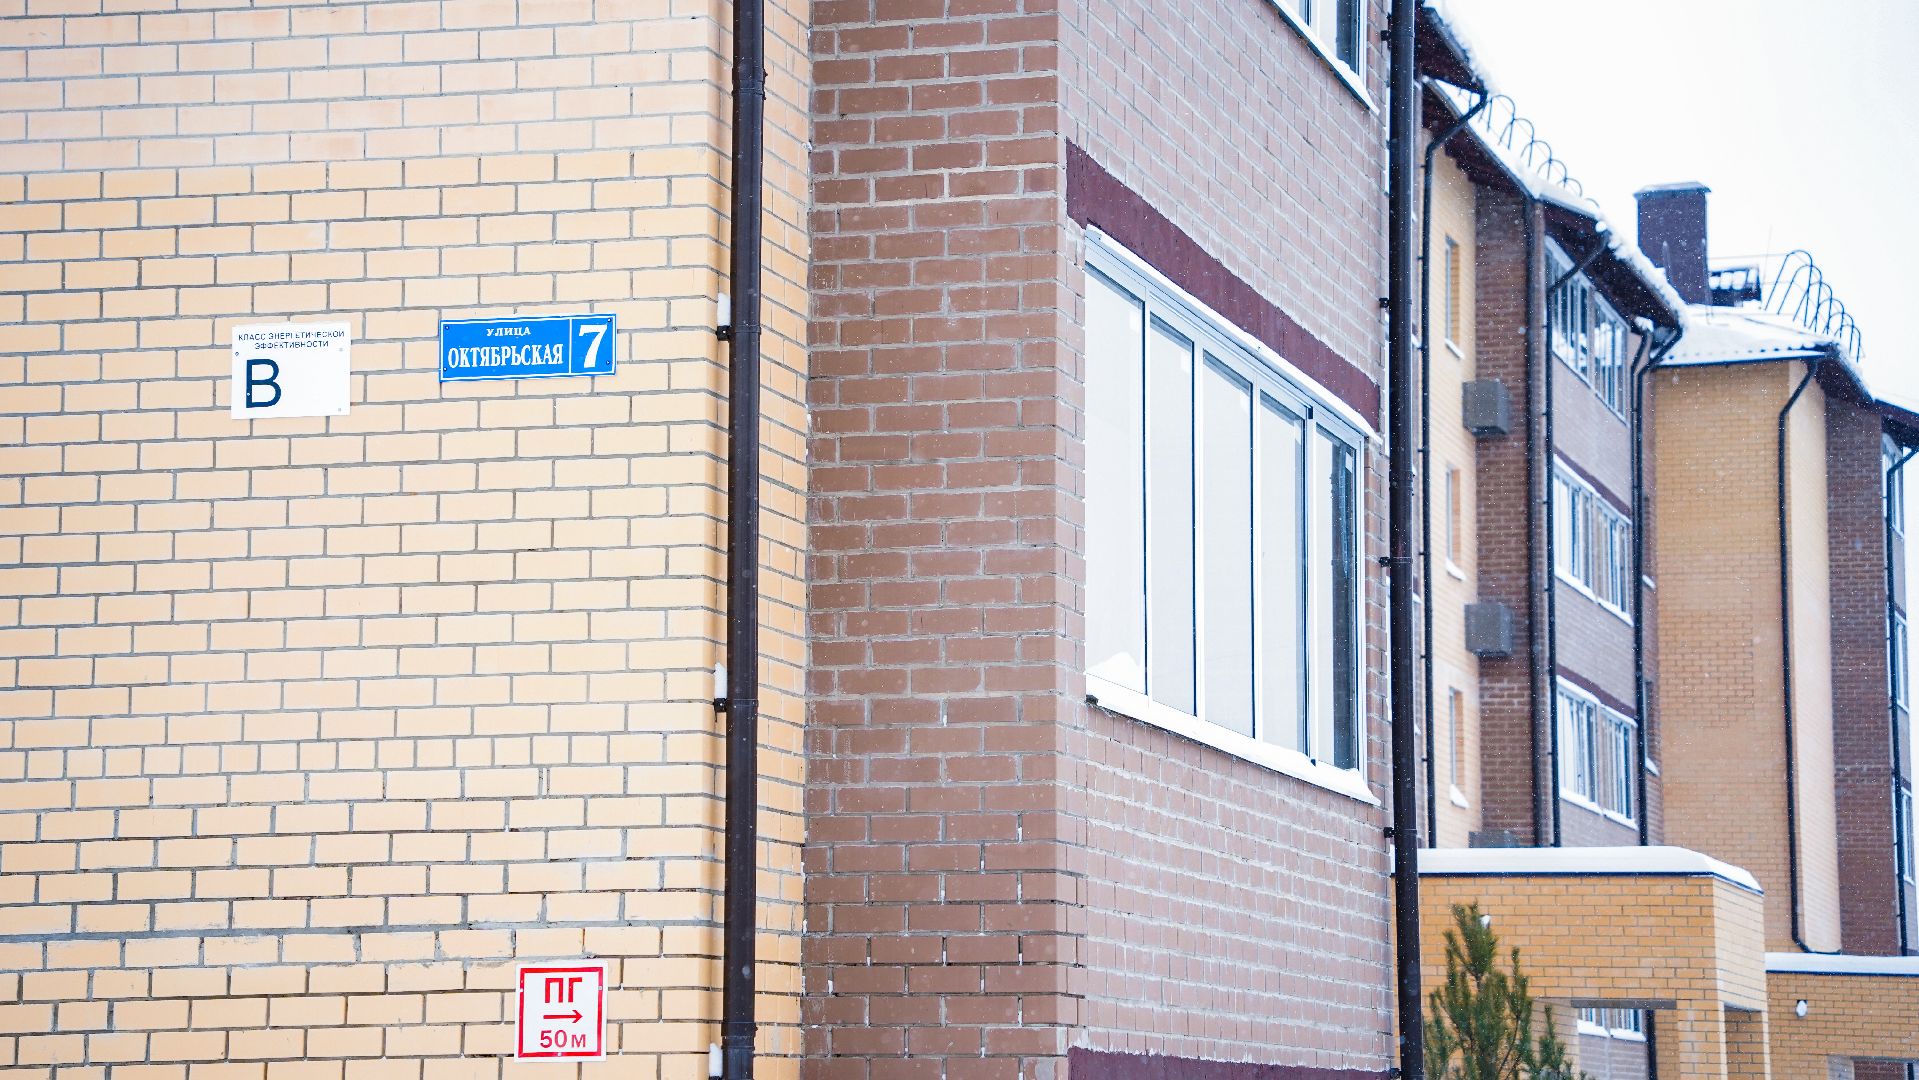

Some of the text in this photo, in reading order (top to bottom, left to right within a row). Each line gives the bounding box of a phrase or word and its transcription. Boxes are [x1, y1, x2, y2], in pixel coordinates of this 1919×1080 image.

[238, 333, 266, 341] КЛАСС
[486, 326, 532, 337] УЛИЦА
[254, 340, 329, 350] ЭФФЕКТИВНОСТИ
[578, 324, 608, 369] 7
[447, 343, 564, 369] ОКТЯБРЬСКАЯ
[544, 976, 583, 1004] ПГ
